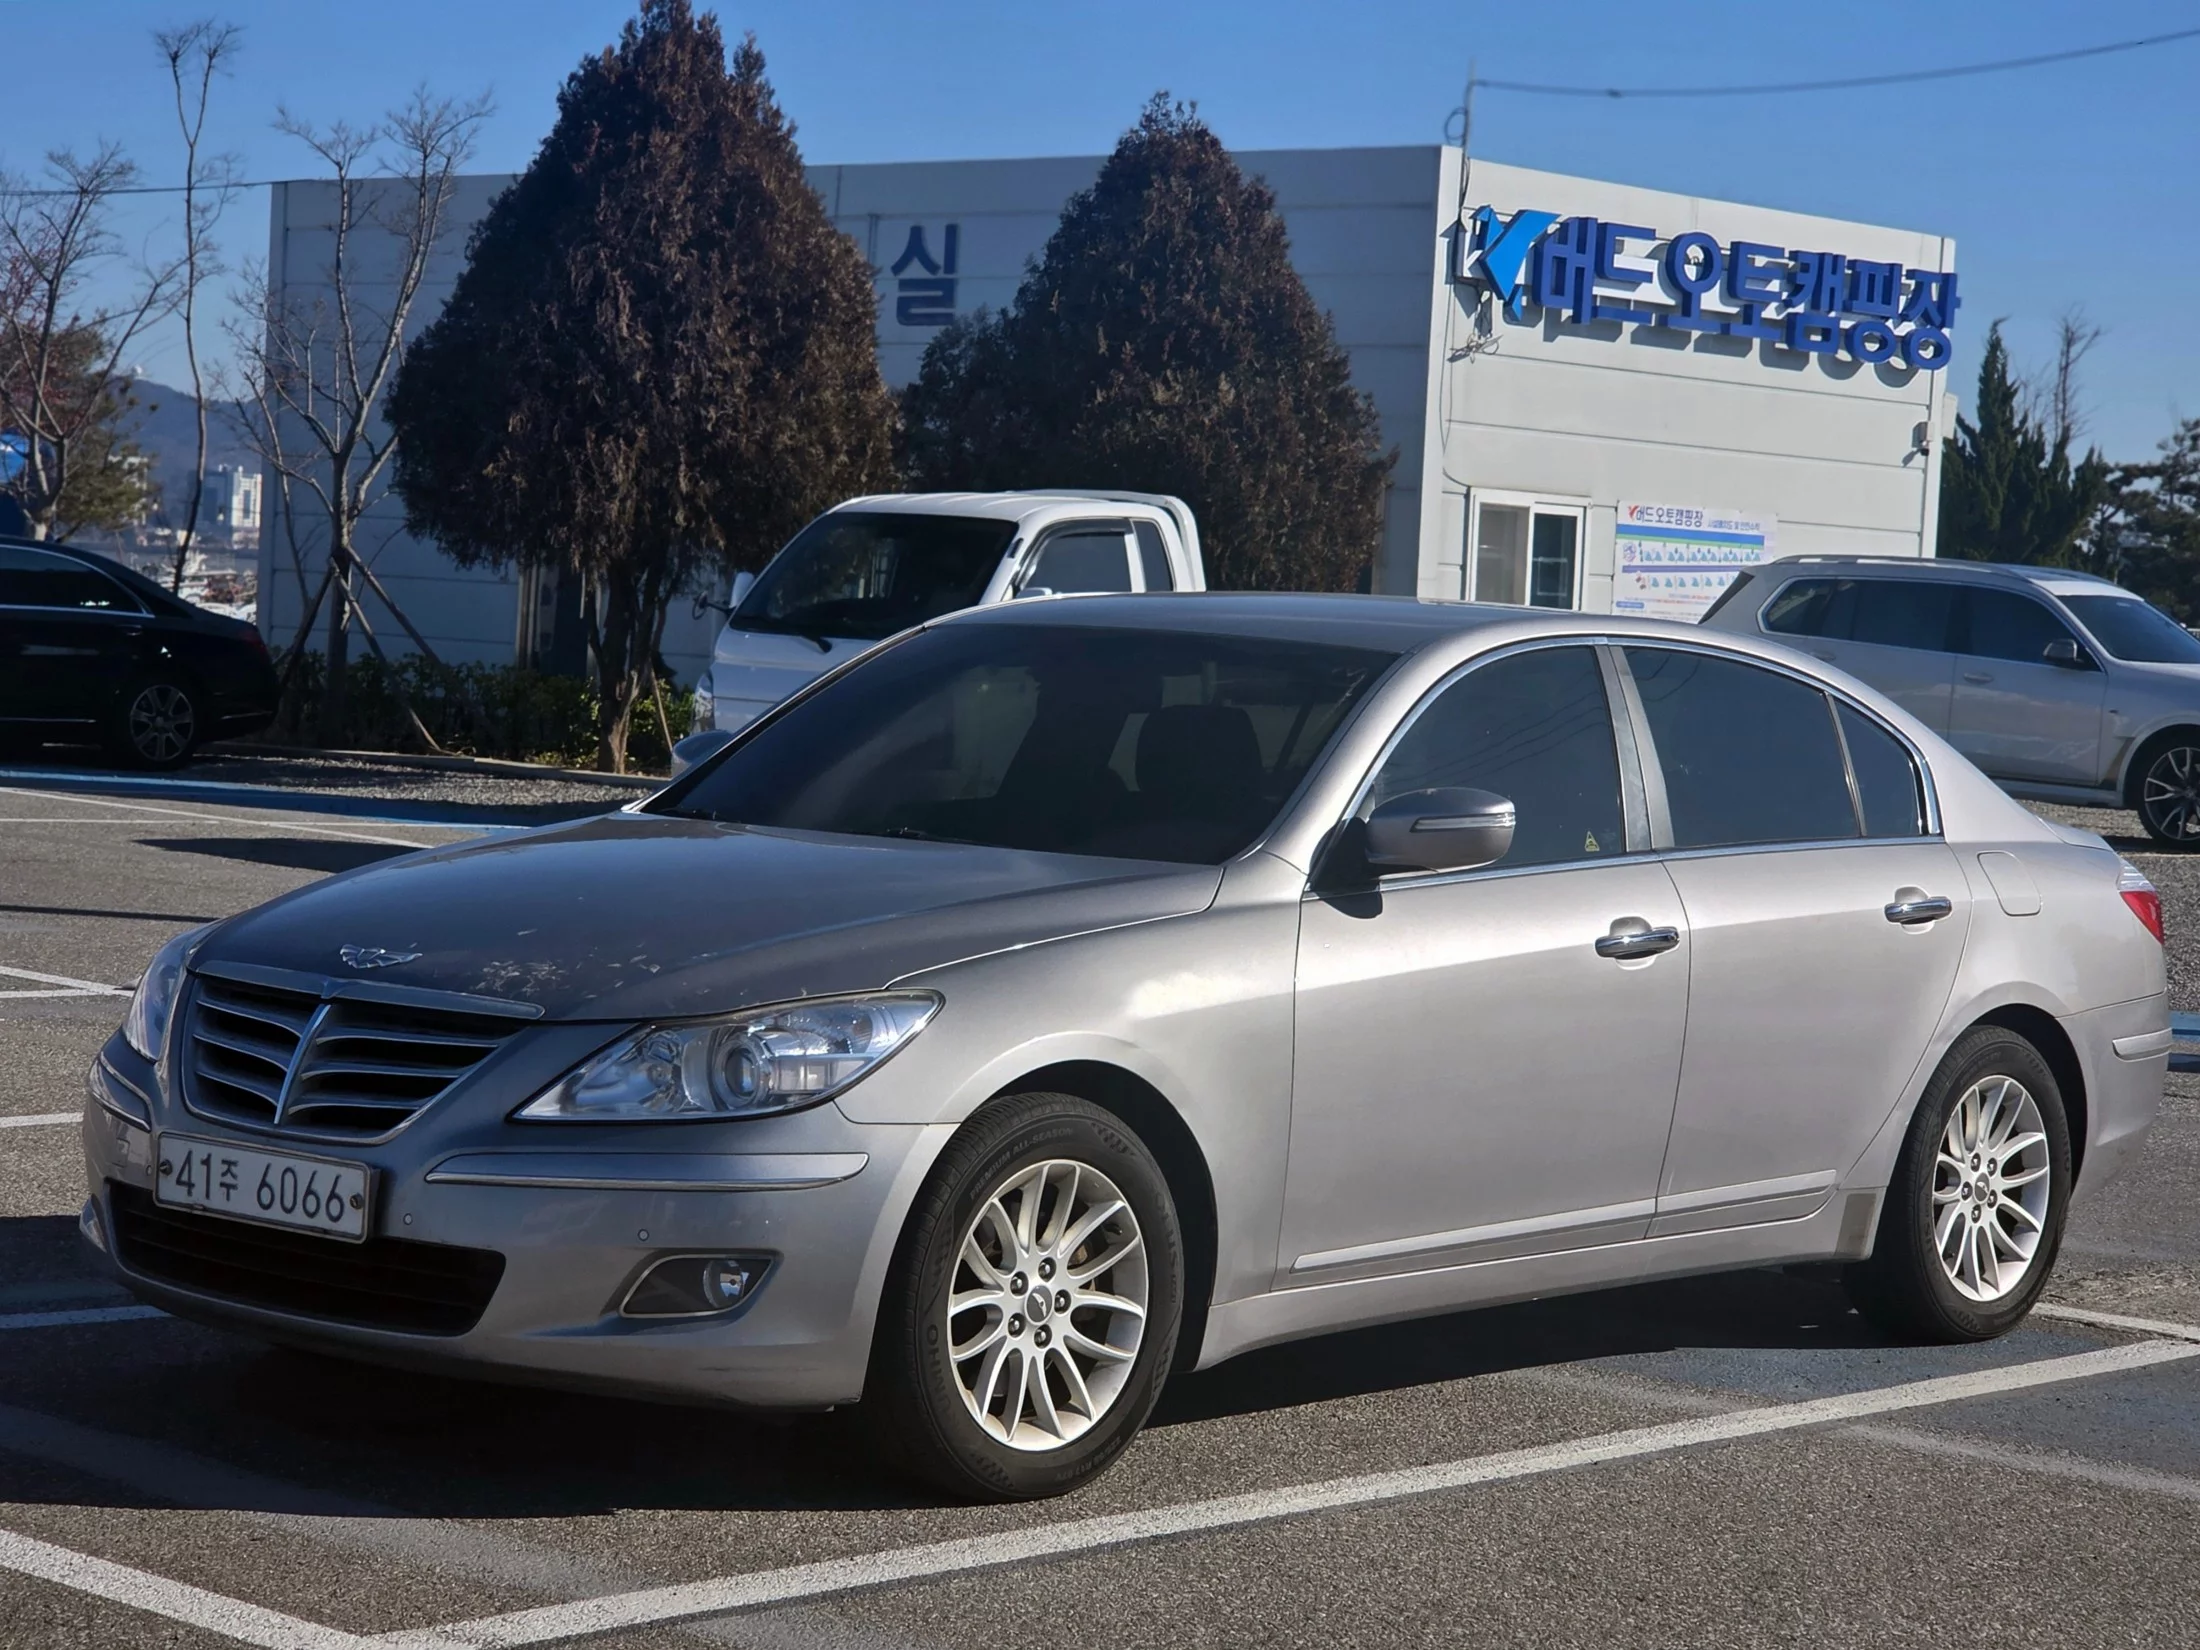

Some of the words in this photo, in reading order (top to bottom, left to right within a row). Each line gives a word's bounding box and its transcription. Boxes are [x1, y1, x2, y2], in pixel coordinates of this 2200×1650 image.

[175, 1149, 239, 1202] 41주
[256, 1162, 345, 1223] 6066
[969, 1151, 1011, 1200] PREMIUM
[1012, 1127, 1074, 1155] ALL-SEASON
